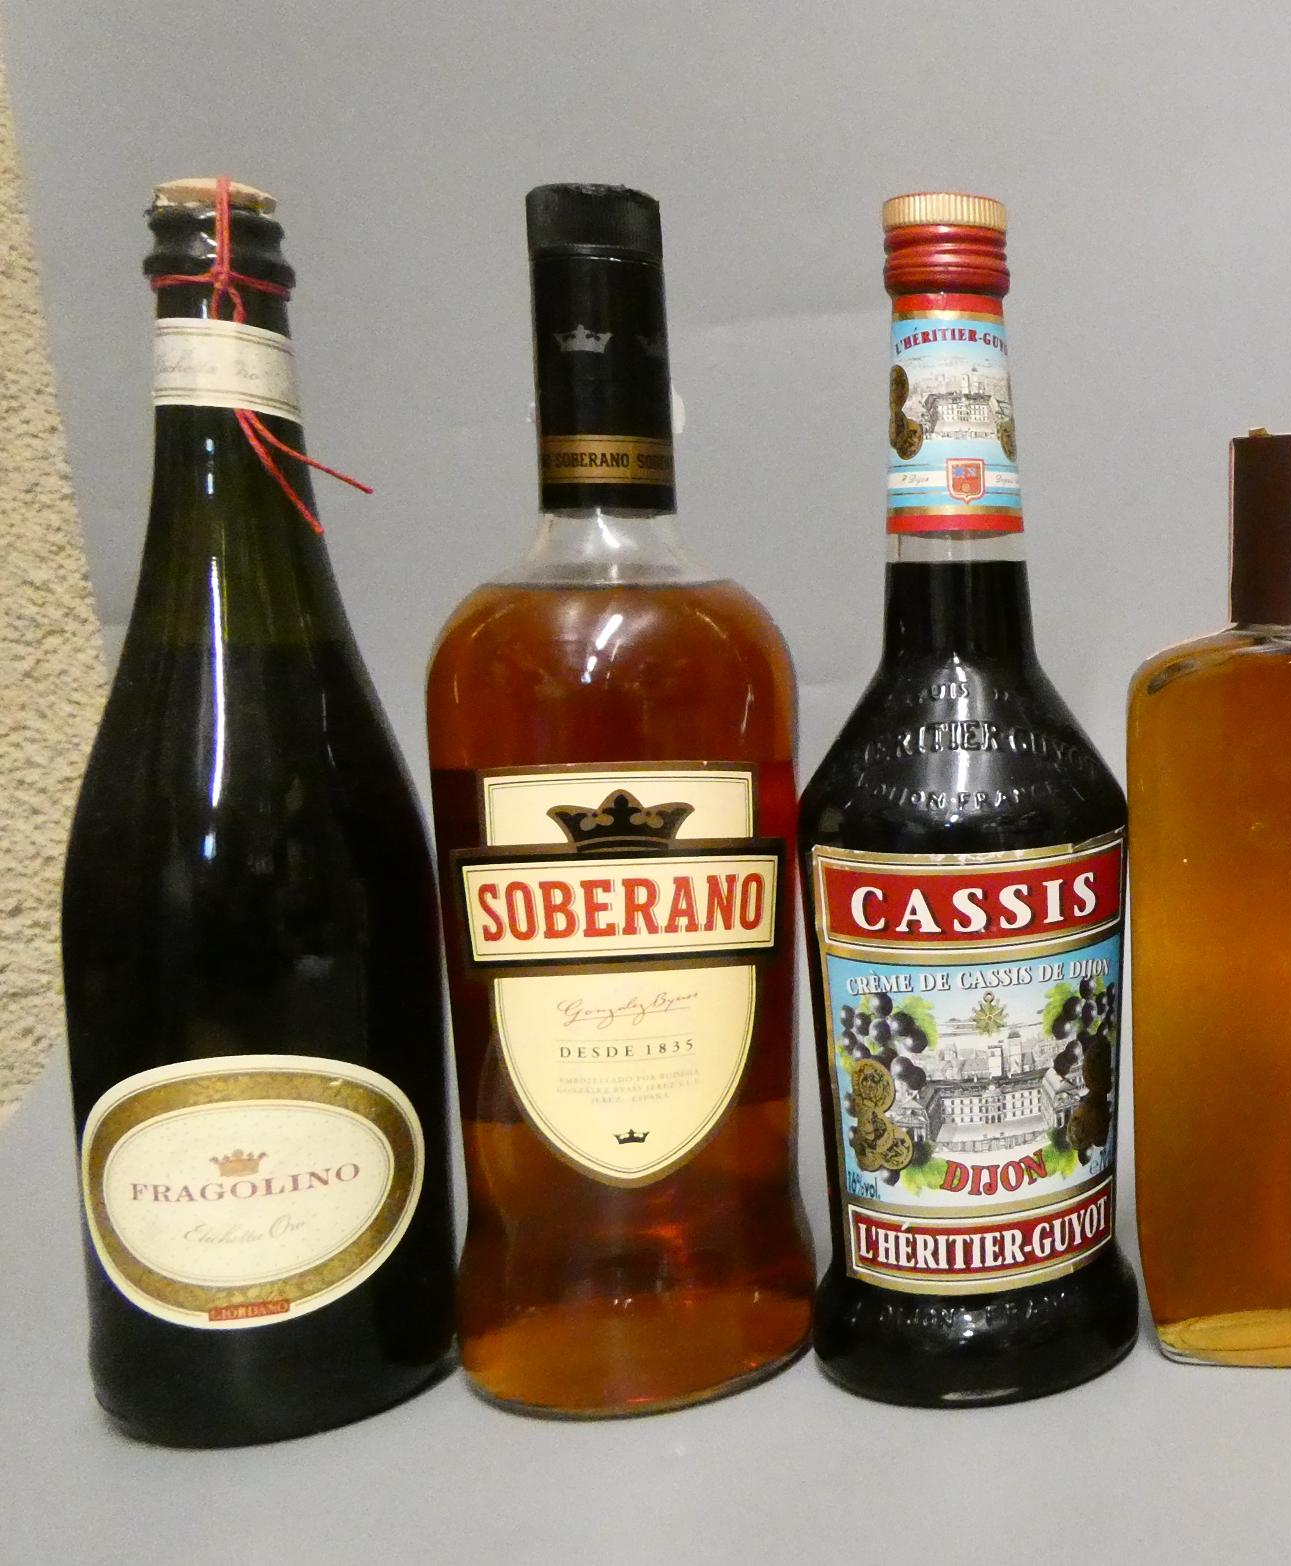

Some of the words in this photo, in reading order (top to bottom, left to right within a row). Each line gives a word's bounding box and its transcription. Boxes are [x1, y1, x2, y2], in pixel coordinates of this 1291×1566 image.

[555, 452, 630, 468] SOBERANO
[477, 872, 765, 943] SOBERANO
[850, 871, 1098, 934] CASSIS
[846, 969, 914, 996] CRÈME
[920, 972, 951, 992] DE
[959, 965, 1034, 990] CASSIS
[1038, 962, 1065, 983] DE
[1068, 958, 1111, 980] DIJON
[559, 1046, 635, 1059] DESDE
[645, 1039, 694, 1056] 1835
[130, 1162, 361, 1202] FRAGOLINO
[940, 1148, 1048, 1196] DIJON
[857, 1195, 1108, 1271] L'HÉRITIER-GUYOT
